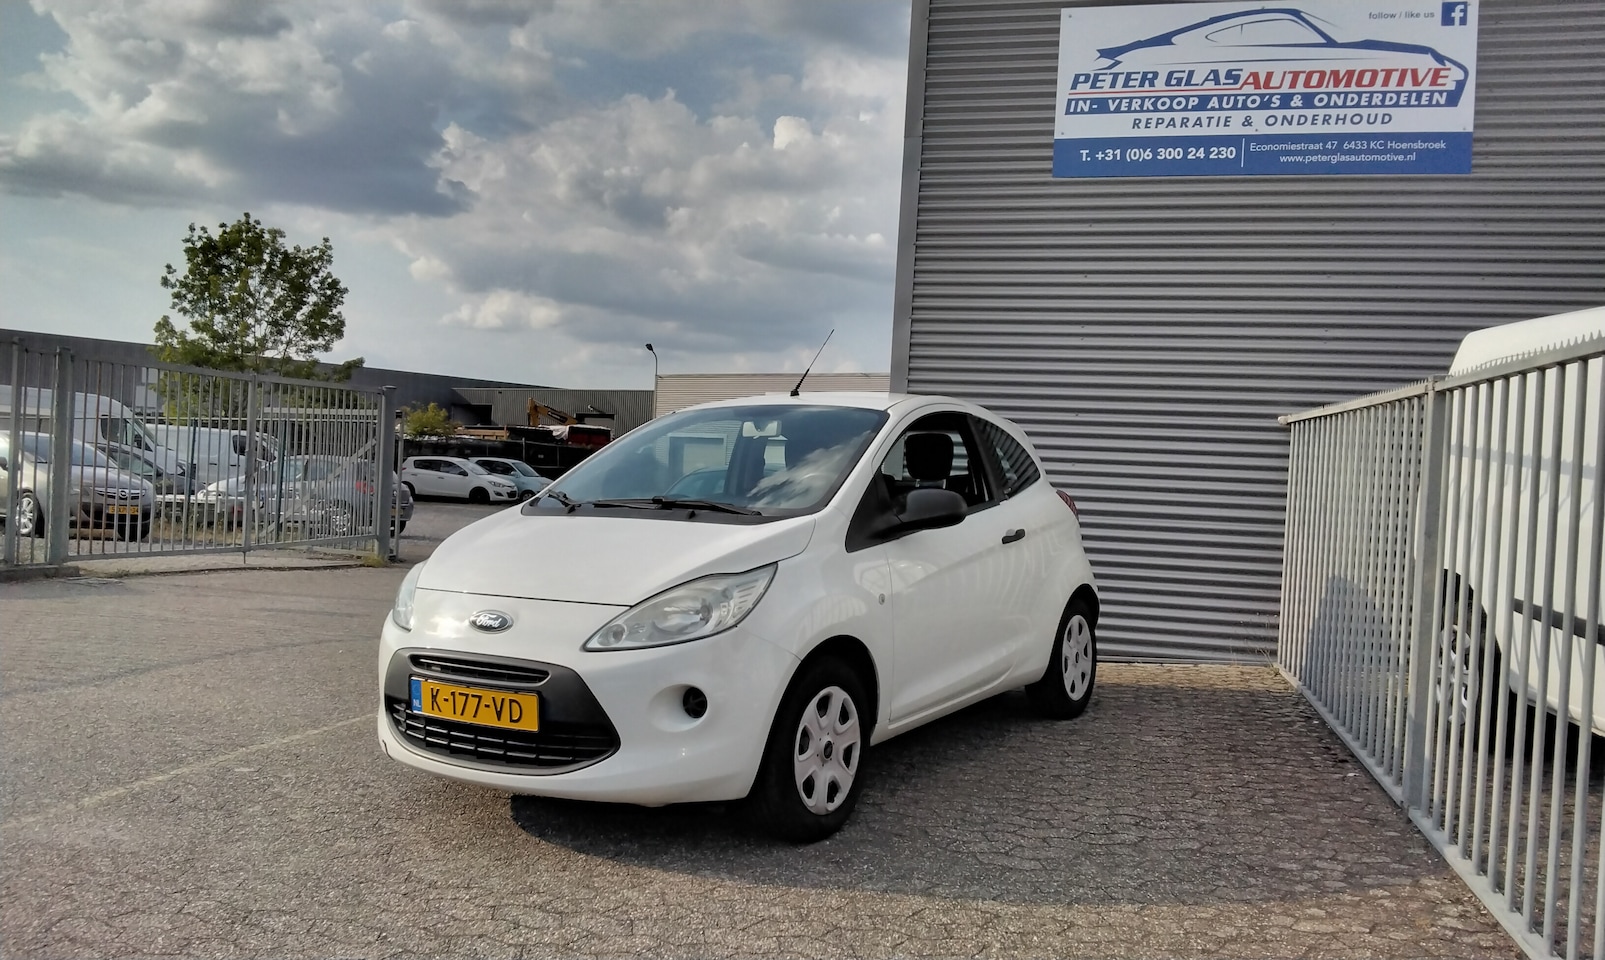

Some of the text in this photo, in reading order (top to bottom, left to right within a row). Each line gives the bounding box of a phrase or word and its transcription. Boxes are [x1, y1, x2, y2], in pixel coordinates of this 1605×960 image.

[1368, 11, 1397, 20] follow
[1405, 10, 1421, 19] like
[1423, 11, 1435, 19] us
[1070, 69, 1160, 91] PETER
[1069, 91, 1448, 113] IN- VERKOOP AUTO'S & ONDERDELEN
[1131, 112, 1393, 130] REPARATIE & ONDERHOUD
[1079, 146, 1236, 162] T. +31 (0)6 300 24 230
[1250, 140, 1446, 152] Economiestraat 47 6433 KC Hoensbroek
[1279, 152, 1416, 164] www.peterglasautomotive.nl
[430, 686, 523, 724] K-177-VD
